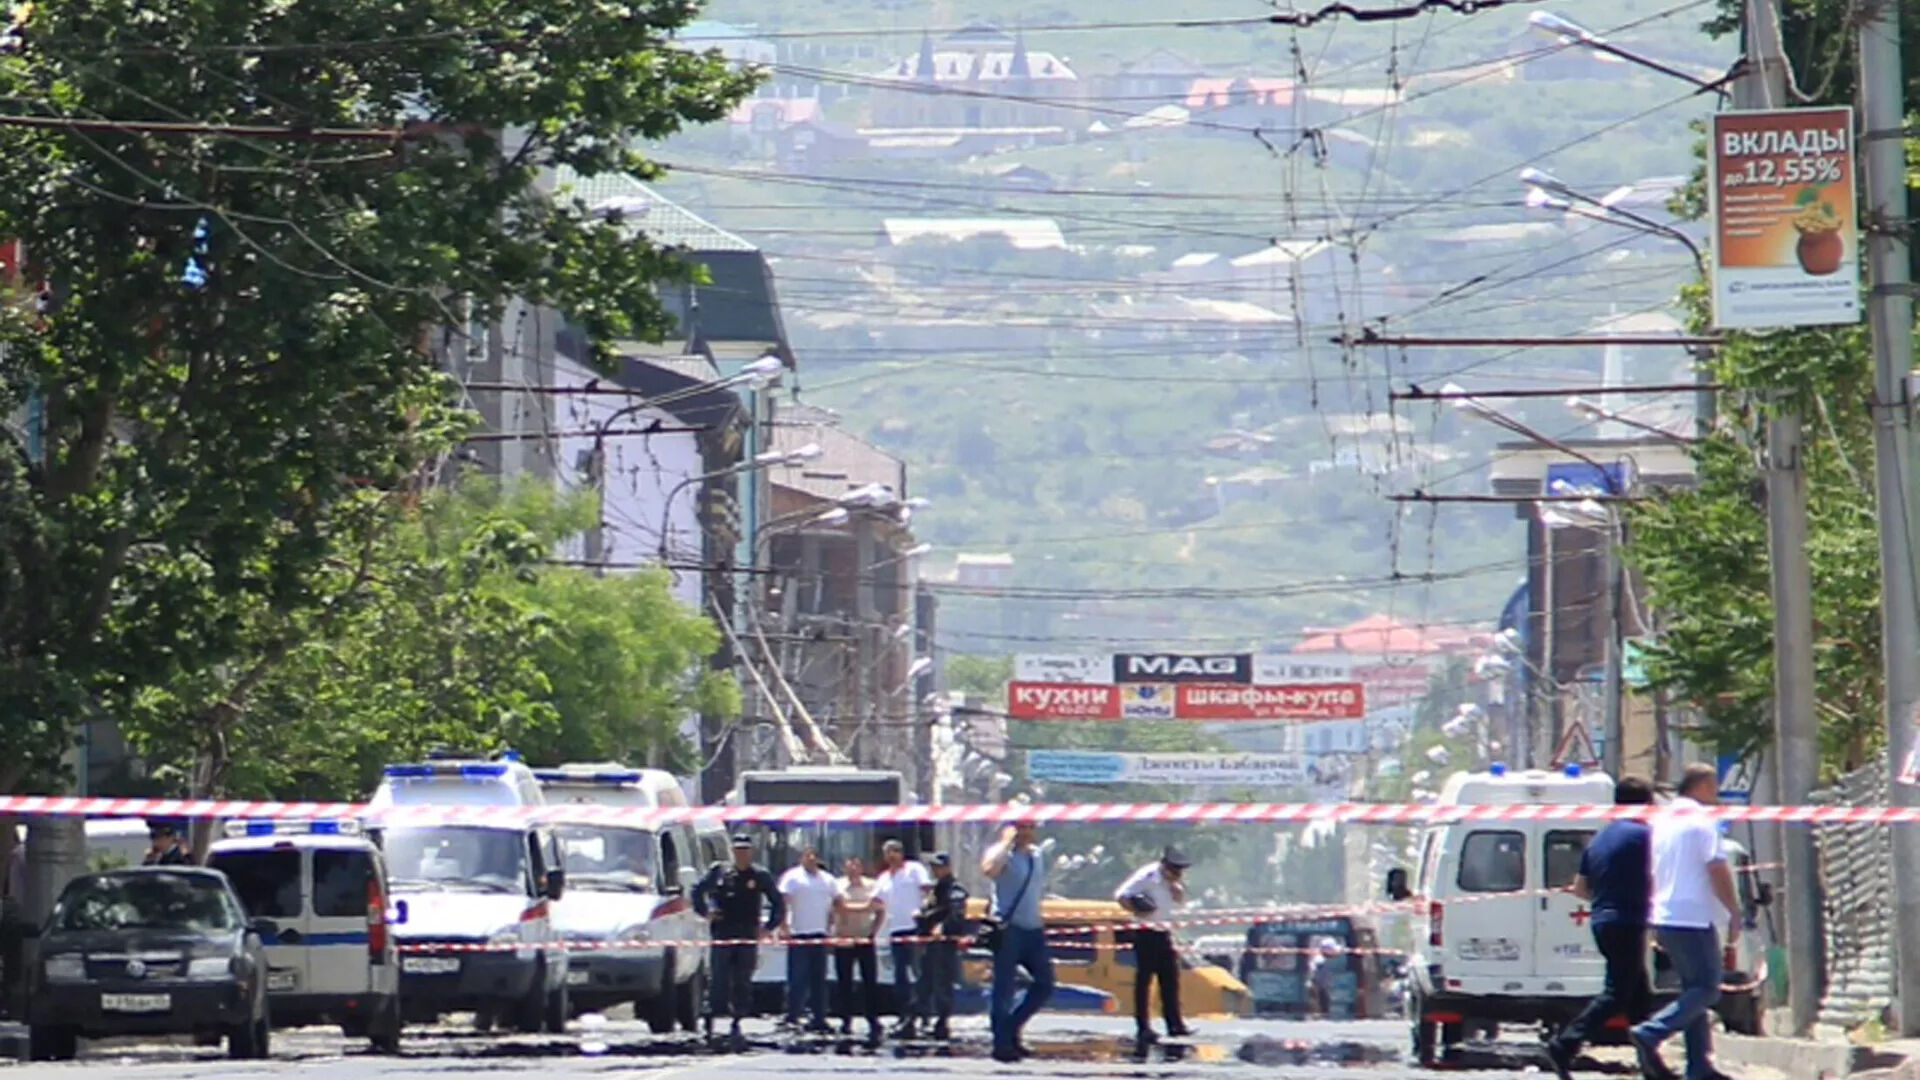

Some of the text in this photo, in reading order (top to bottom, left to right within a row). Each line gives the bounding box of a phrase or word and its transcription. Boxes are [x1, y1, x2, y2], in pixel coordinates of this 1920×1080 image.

[1723, 128, 1846, 156] ВКЛАДЫ
[1725, 157, 1842, 187] до 12,55%
[1128, 656, 1237, 675] MAG
